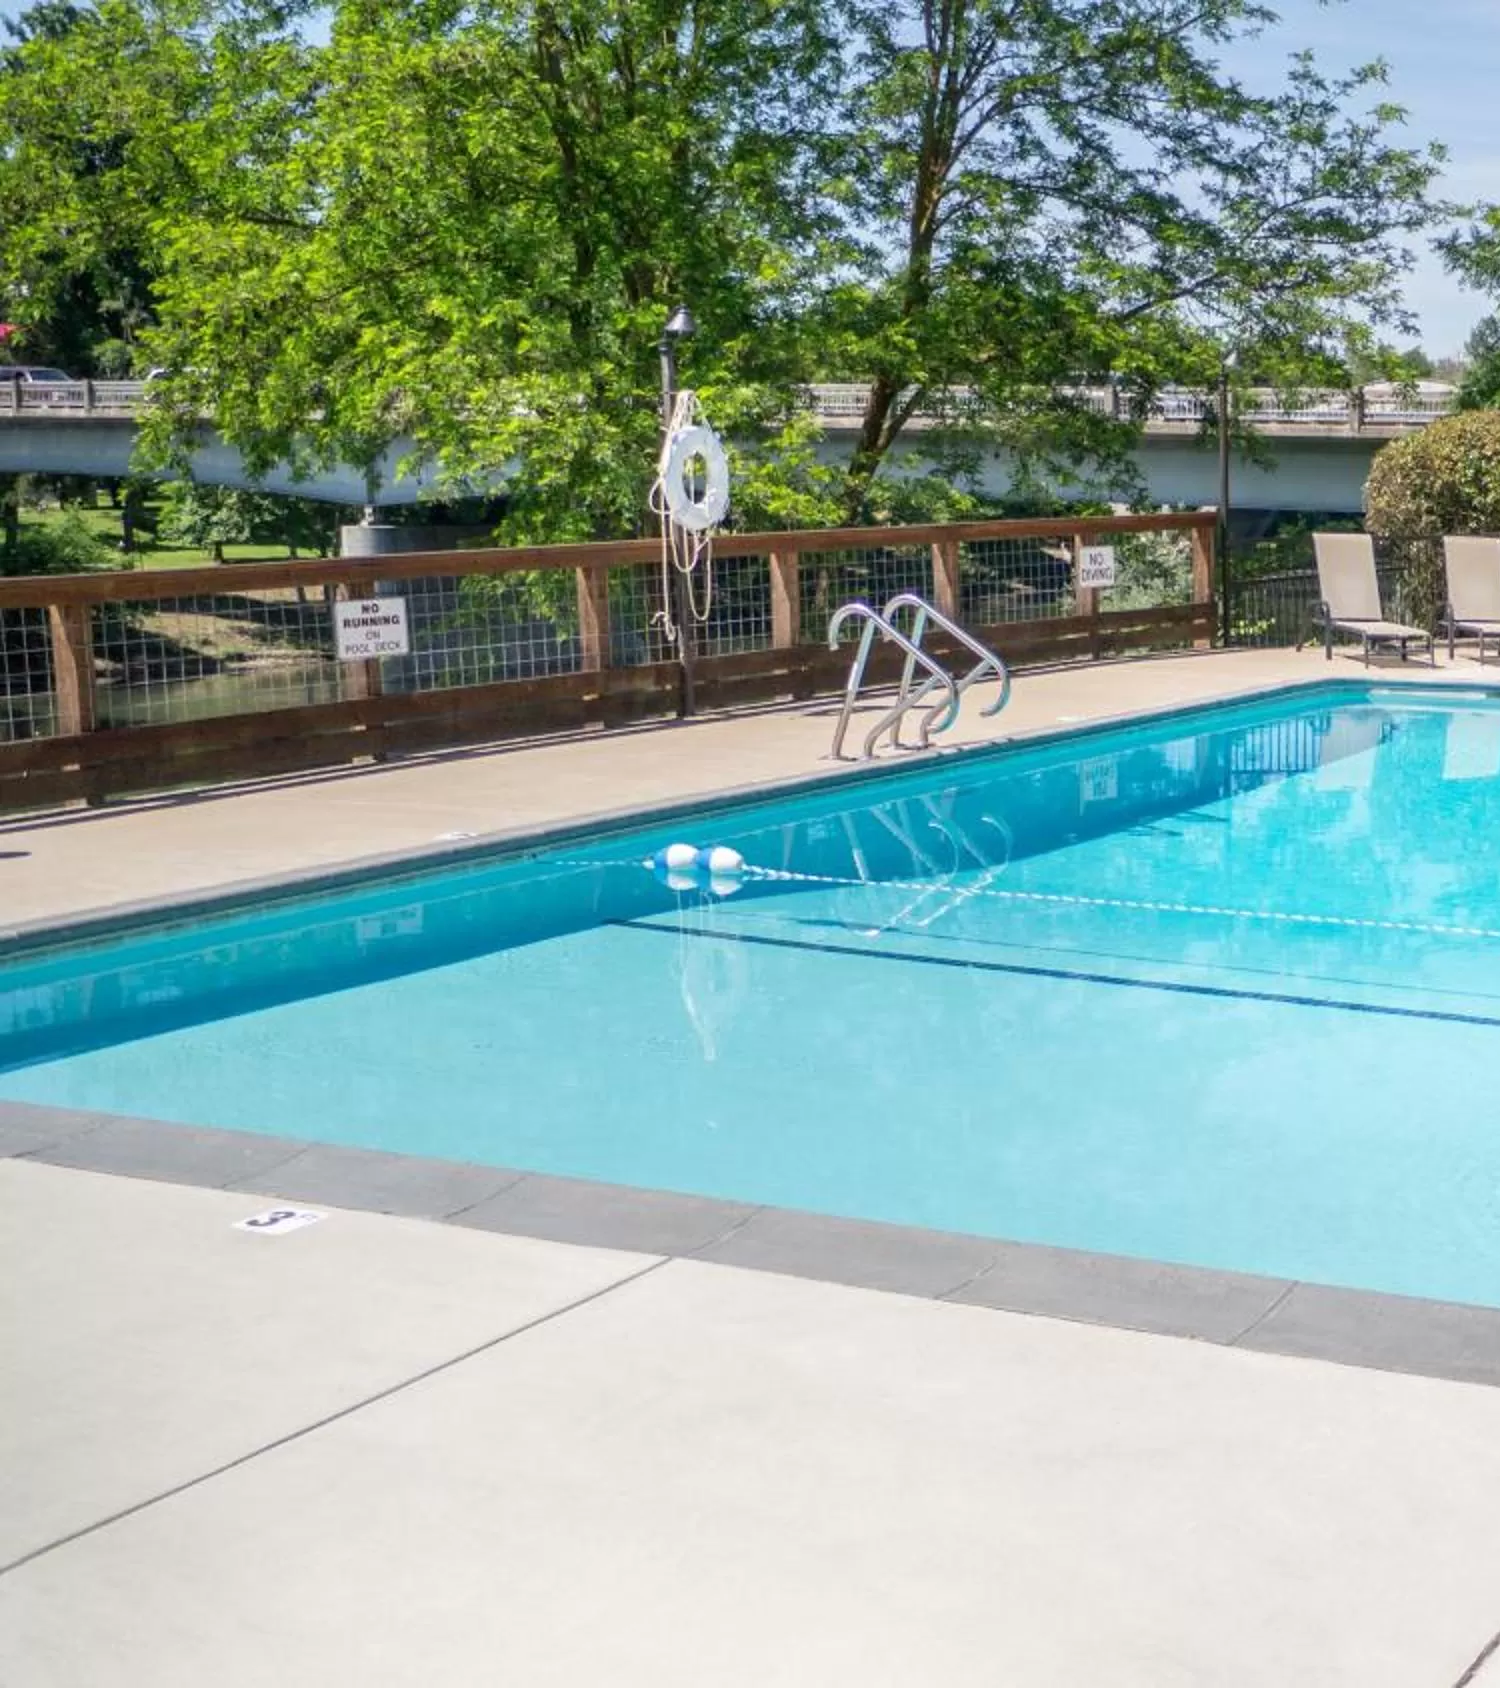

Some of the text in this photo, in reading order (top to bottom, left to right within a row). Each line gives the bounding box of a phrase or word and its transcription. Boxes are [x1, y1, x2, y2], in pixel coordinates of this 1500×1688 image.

[1089, 552, 1104, 566] NO
[1081, 566, 1113, 581] DIVING
[361, 603, 379, 614] NO
[343, 614, 400, 629] RUNNING
[365, 631, 381, 640] ON
[345, 640, 400, 655] POOL DECK
[244, 1211, 297, 1227] 3
